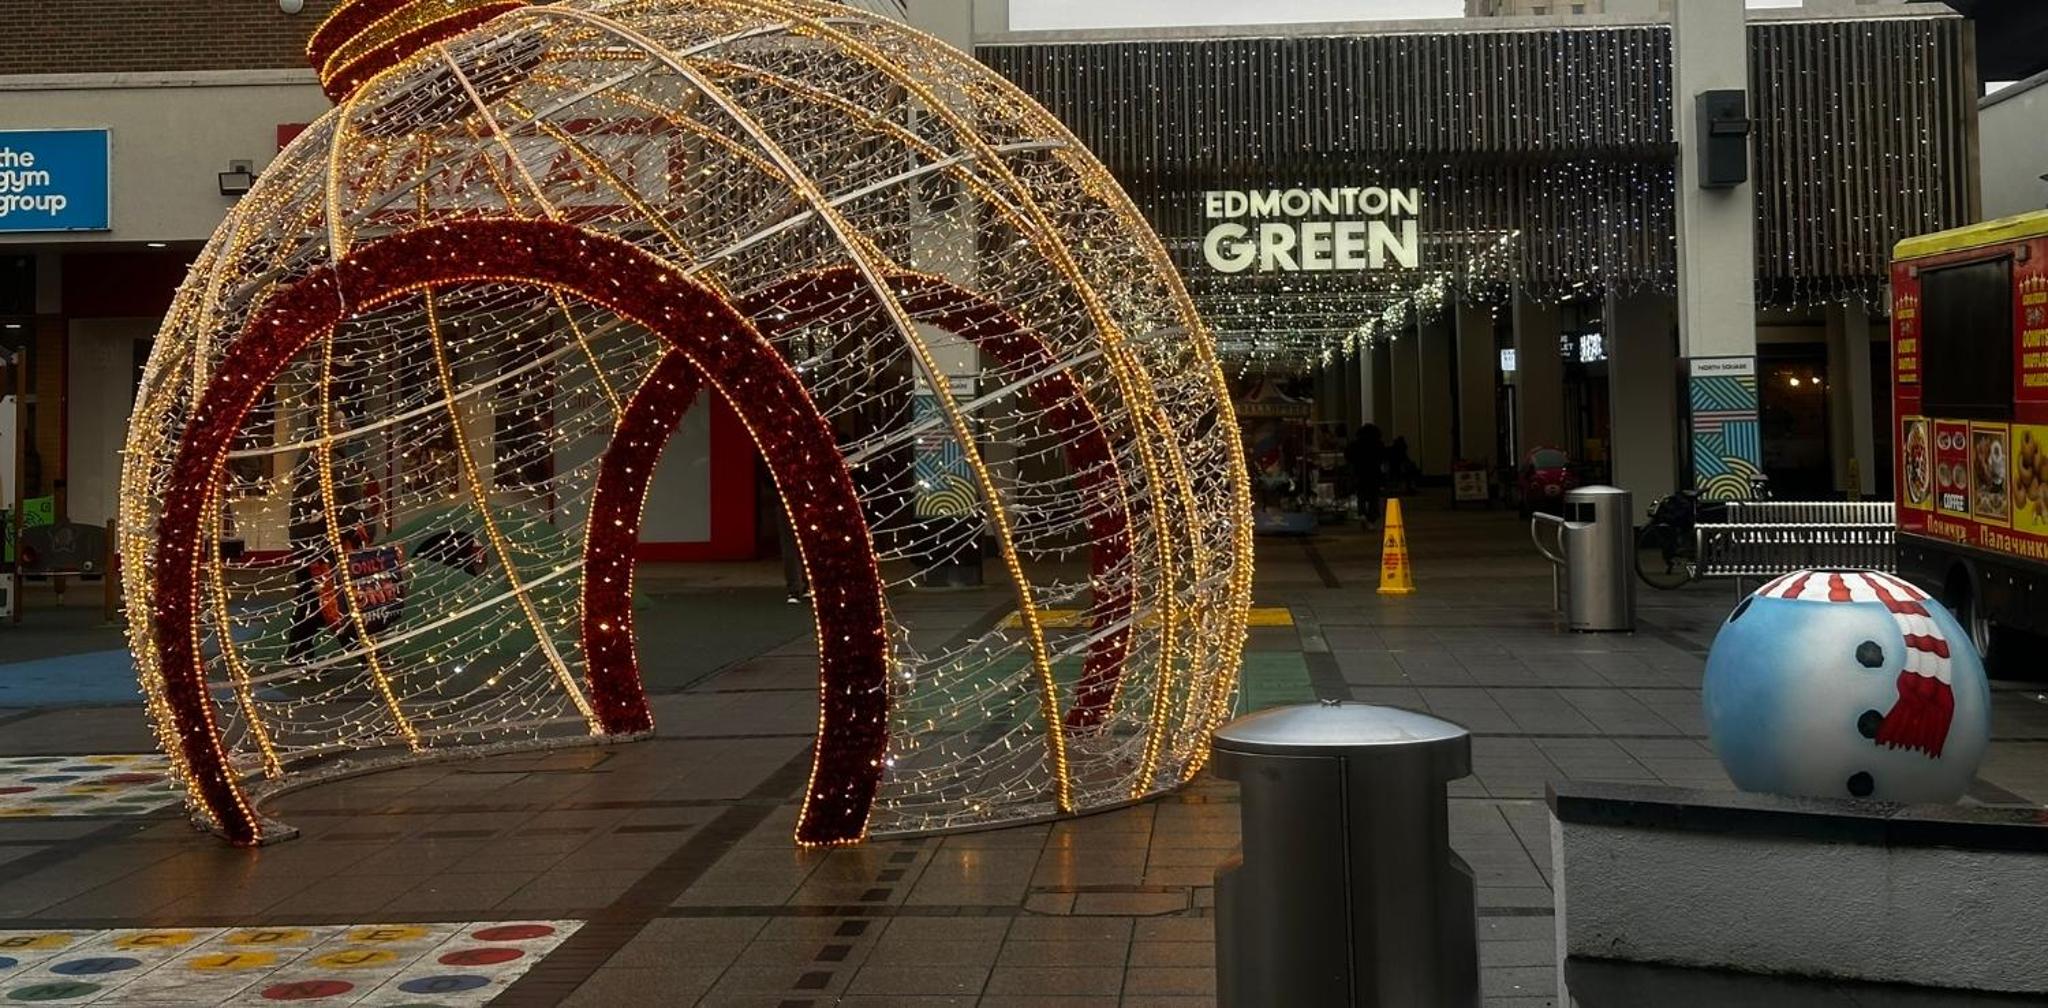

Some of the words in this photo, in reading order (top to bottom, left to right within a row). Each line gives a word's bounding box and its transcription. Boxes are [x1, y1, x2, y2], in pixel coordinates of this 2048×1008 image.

[0, 170, 49, 193] gym
[0, 195, 67, 217] group
[1205, 187, 1418, 218] EDMONTON
[1203, 220, 1419, 273] GREEN
[1723, 362, 1746, 370] SQUARE
[1943, 493, 1965, 511] COFFEE
[352, 555, 386, 574] ONLY
[131, 935, 169, 945] C
[250, 932, 285, 942] D
[363, 929, 404, 940] E
